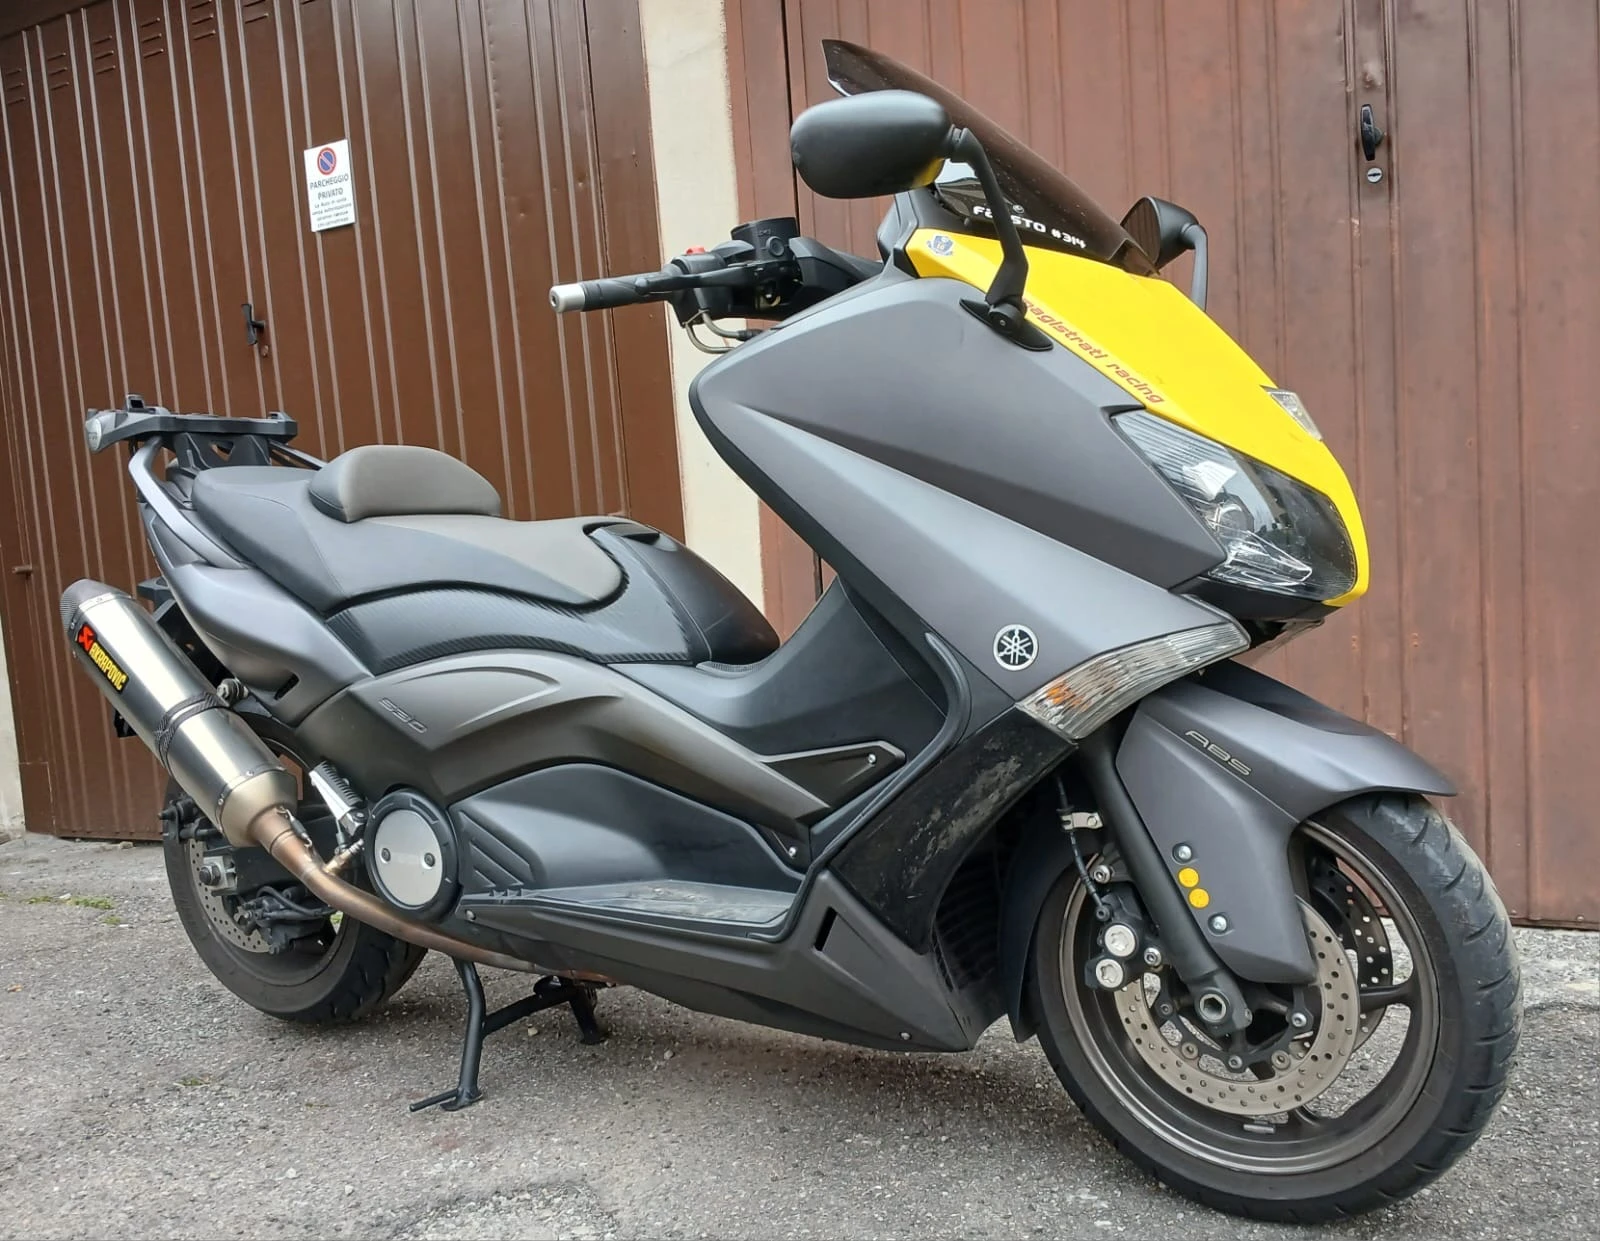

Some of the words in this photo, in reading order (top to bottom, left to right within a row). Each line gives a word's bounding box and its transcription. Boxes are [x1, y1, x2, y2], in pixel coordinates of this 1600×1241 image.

[310, 173, 349, 189] PARCHEGGIO
[317, 187, 344, 200] PRIVATO
[1106, 363, 1165, 404] racing
[378, 697, 428, 734] 530
[1185, 730, 1252, 776] ABS
